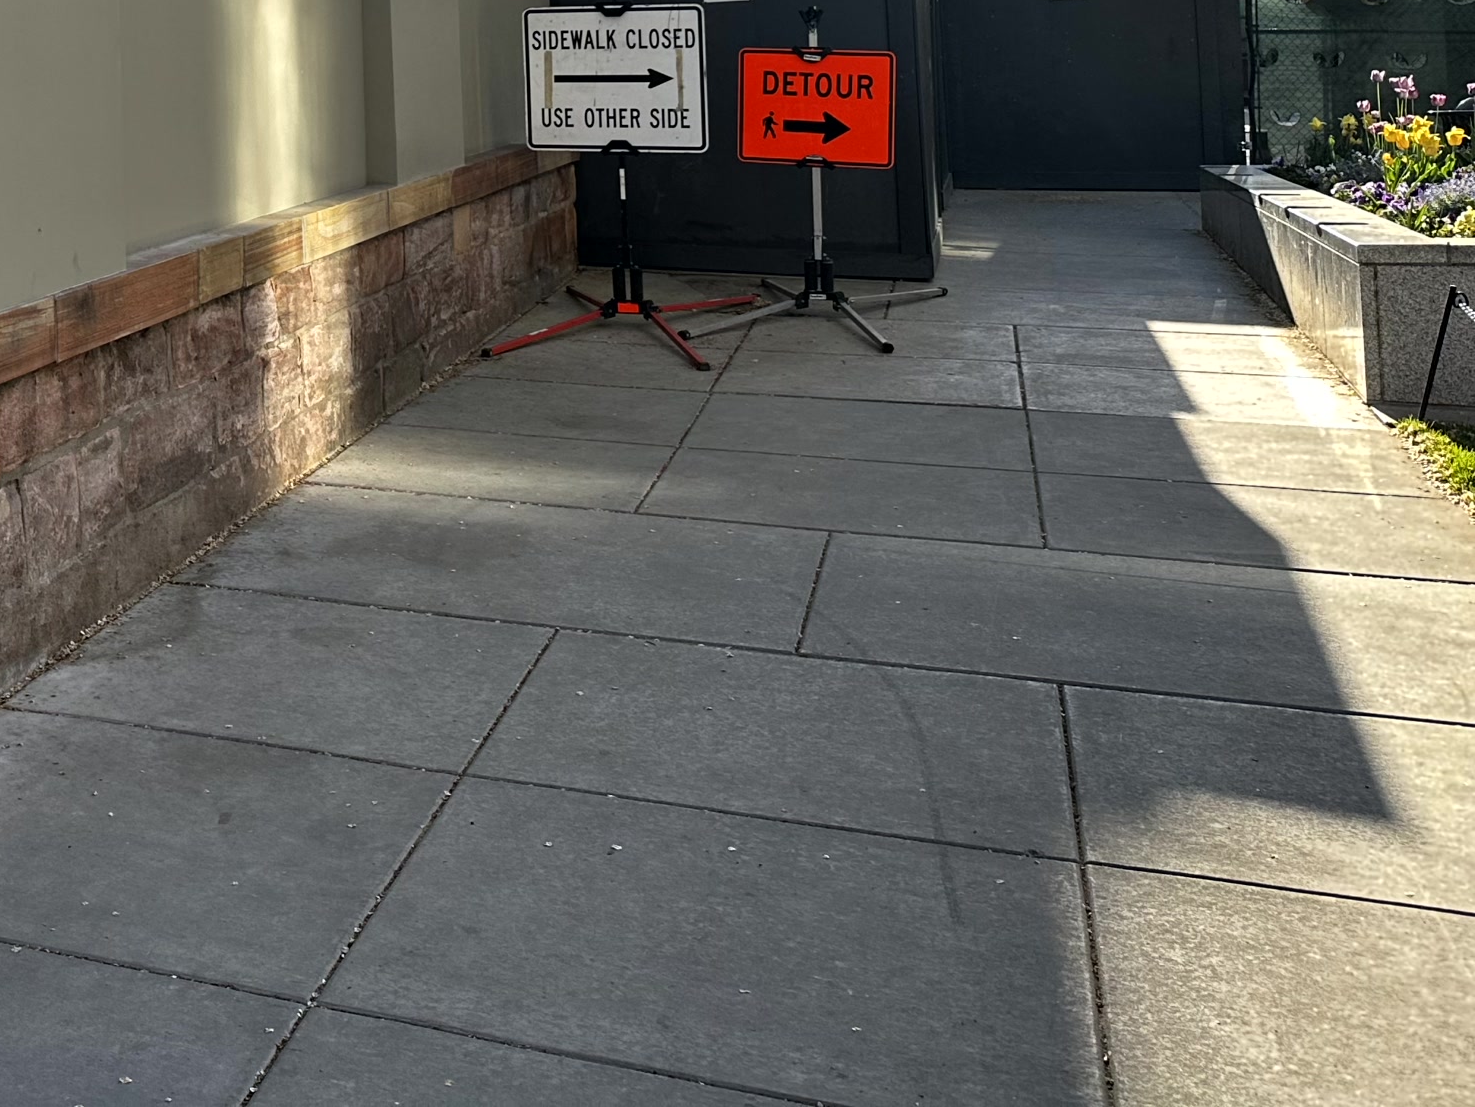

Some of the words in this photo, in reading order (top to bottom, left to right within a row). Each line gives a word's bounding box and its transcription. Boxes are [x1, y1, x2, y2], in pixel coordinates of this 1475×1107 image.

[531, 29, 617, 51] SIDEWALK
[626, 28, 696, 50] CLOSED
[762, 70, 874, 100] DETOUR
[541, 108, 574, 128] USE
[584, 108, 641, 129] OTHER
[649, 108, 691, 129] SIDE
